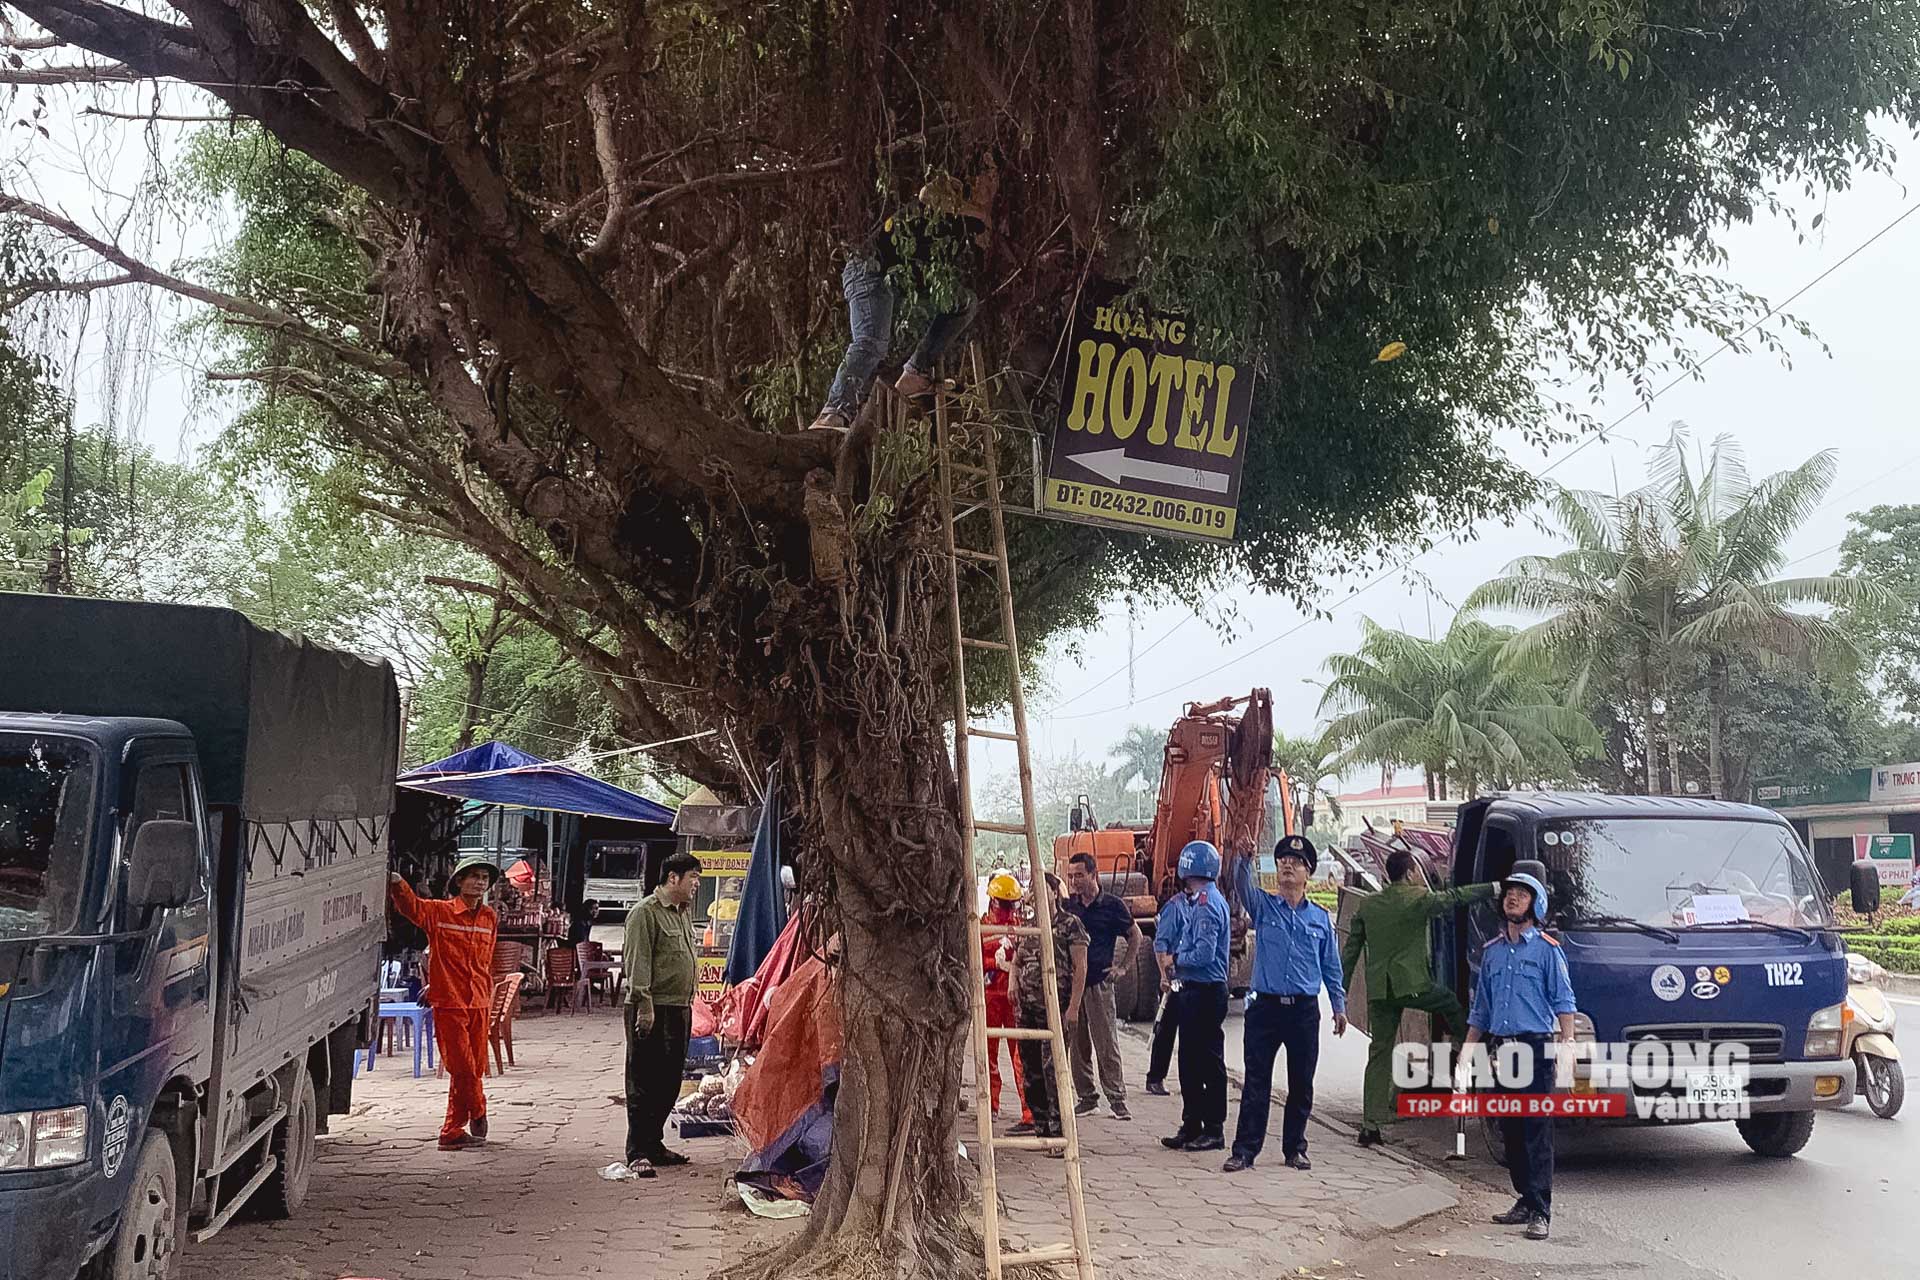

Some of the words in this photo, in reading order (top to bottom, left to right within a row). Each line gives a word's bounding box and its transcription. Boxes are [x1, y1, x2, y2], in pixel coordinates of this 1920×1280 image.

[1093, 306, 1186, 345] HOÀNG
[1066, 339, 1239, 457] HOTEL
[1056, 483, 1085, 506] ĐT:
[1089, 489, 1226, 529] 02432.006.019
[1892, 771, 1915, 787] TRUNG
[1764, 962, 1803, 986] TH22
